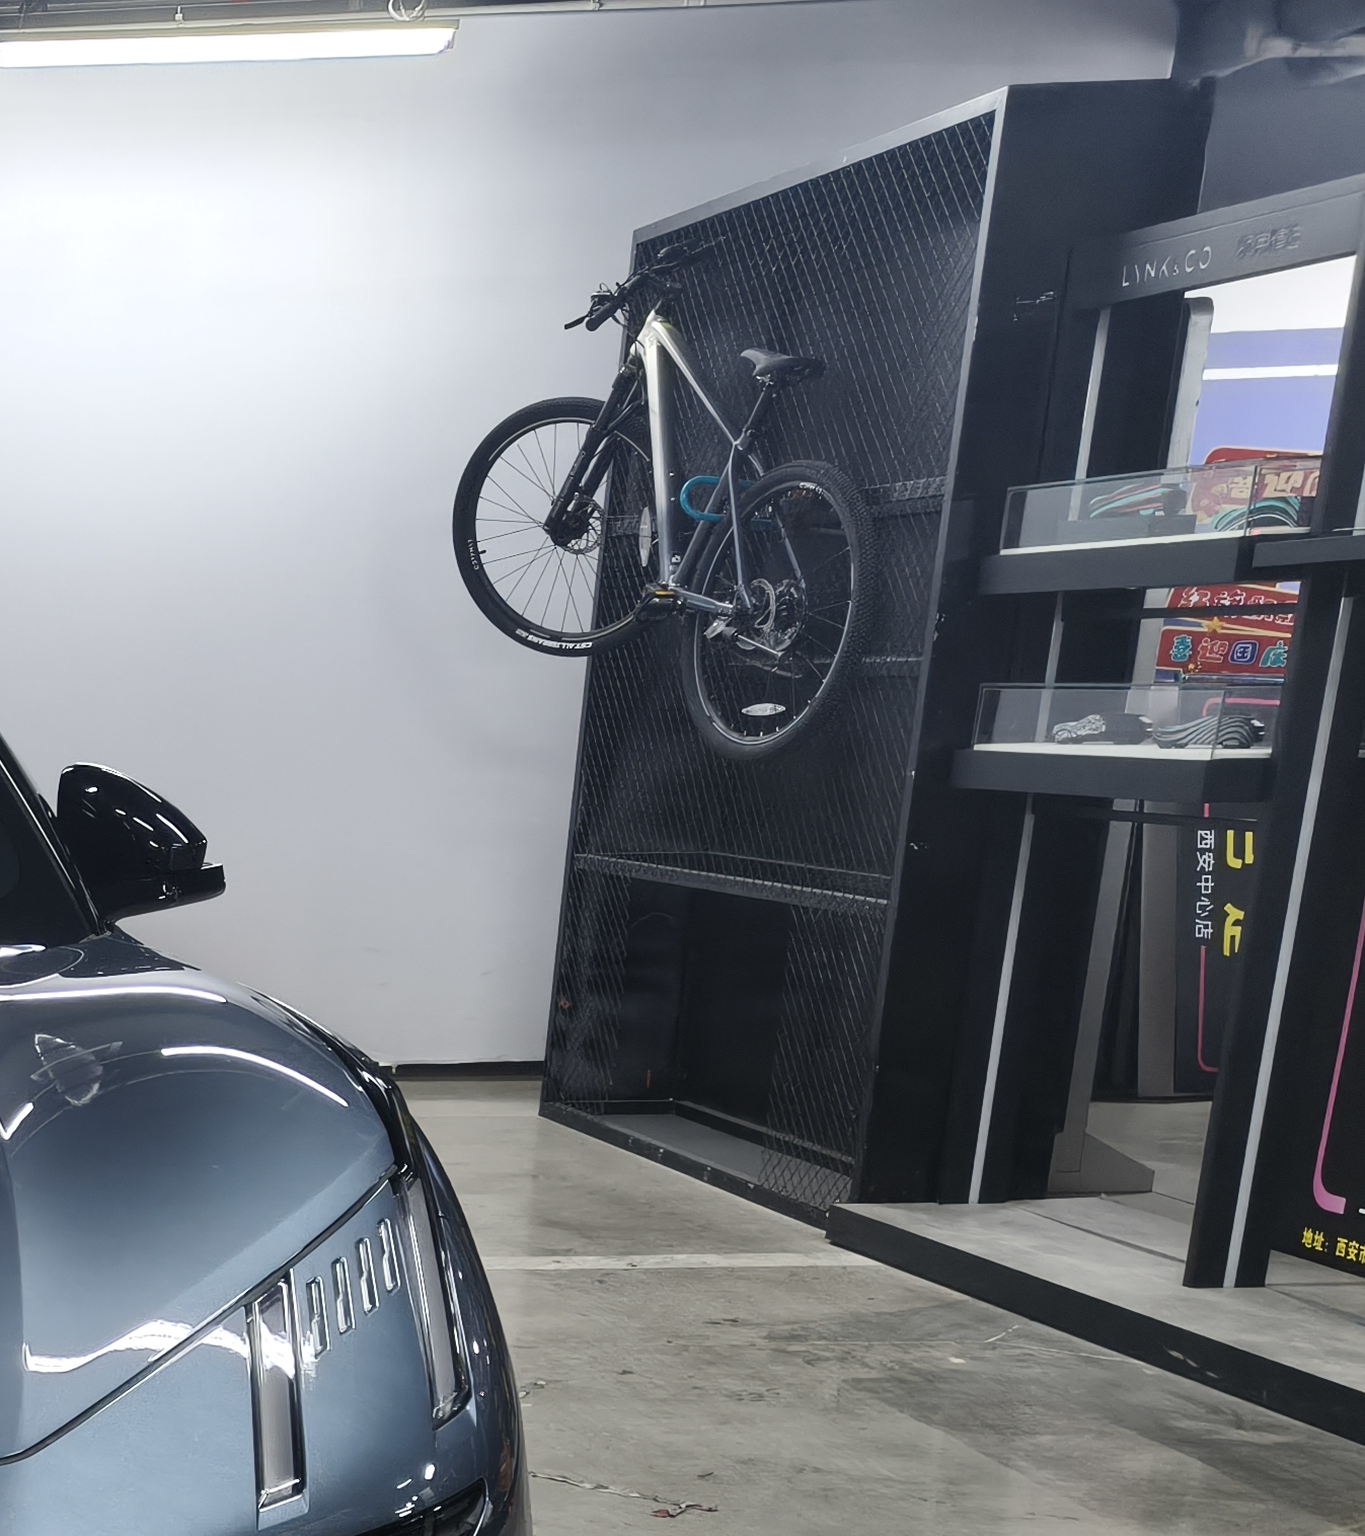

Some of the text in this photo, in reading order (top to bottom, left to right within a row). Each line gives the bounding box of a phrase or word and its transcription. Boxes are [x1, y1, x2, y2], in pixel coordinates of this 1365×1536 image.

[1195, 829, 1215, 939] 西安中心店
